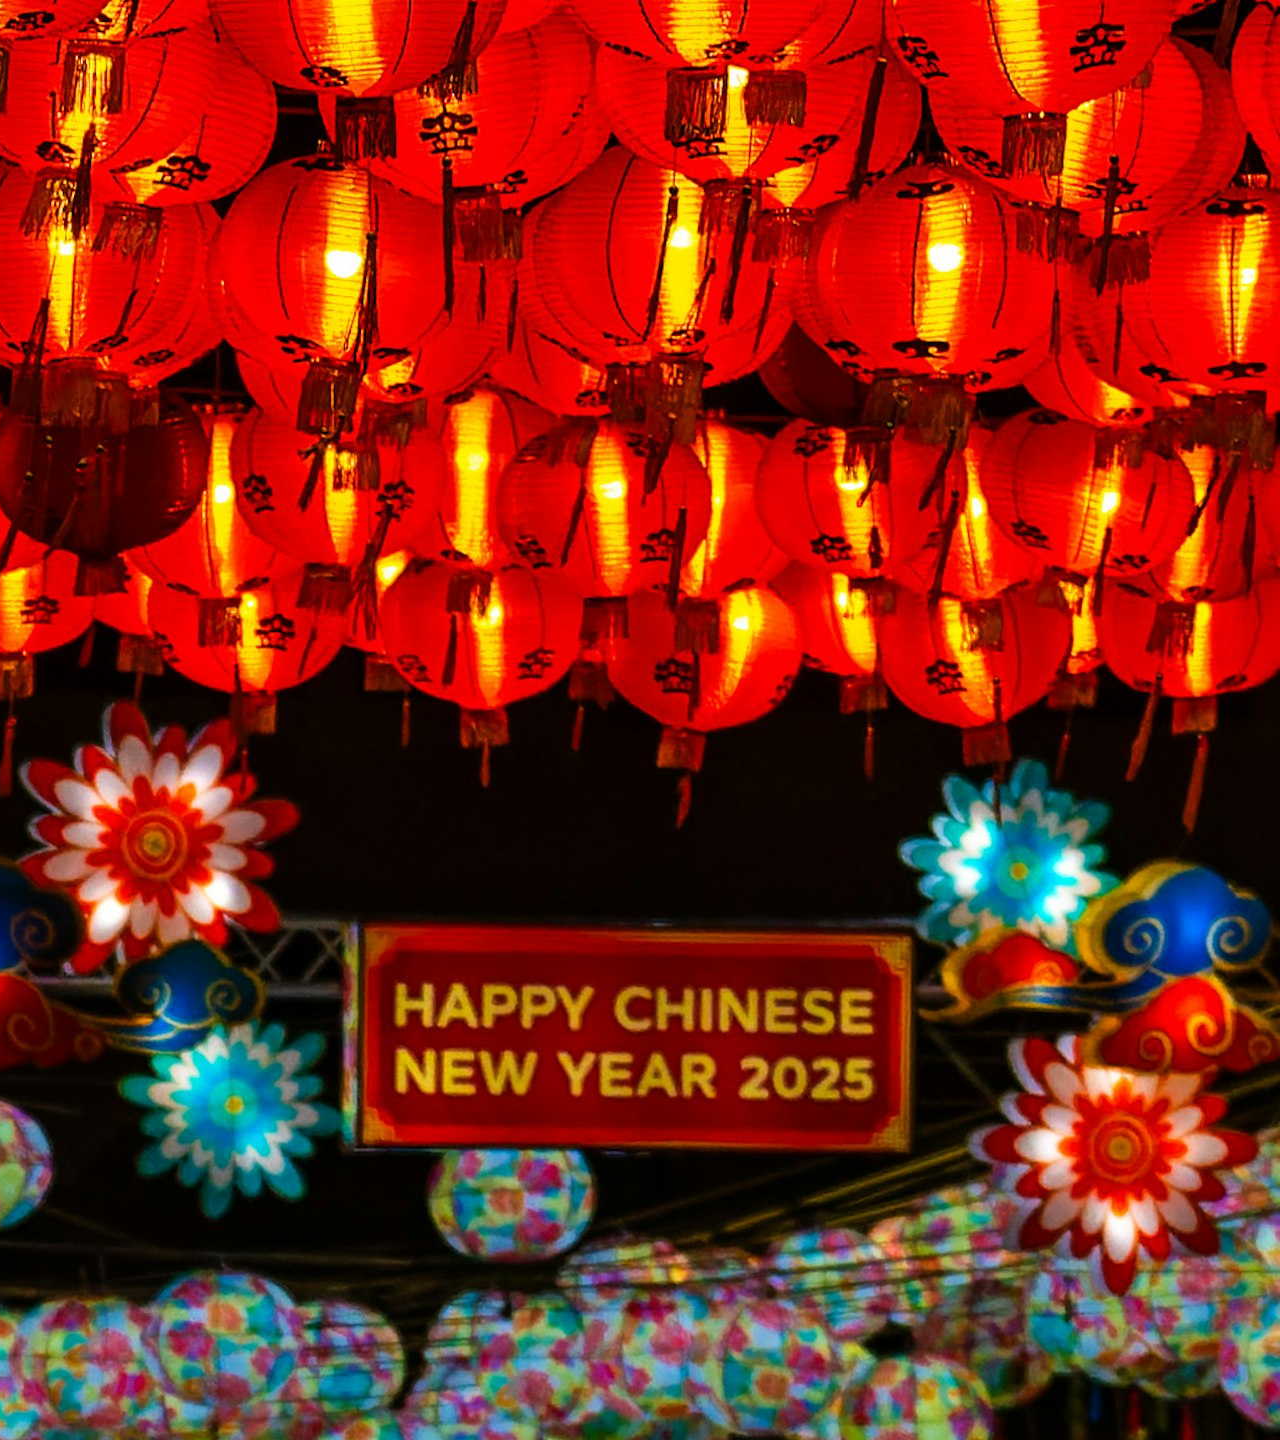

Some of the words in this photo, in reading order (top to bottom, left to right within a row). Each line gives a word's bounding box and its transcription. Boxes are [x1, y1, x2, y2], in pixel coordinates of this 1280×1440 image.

[393, 983, 596, 1031] HAPPY
[613, 986, 875, 1036] CHINESE
[393, 1047, 539, 1097] NEW
[557, 1051, 718, 1098] YEAR
[739, 1056, 875, 1102] 2025
